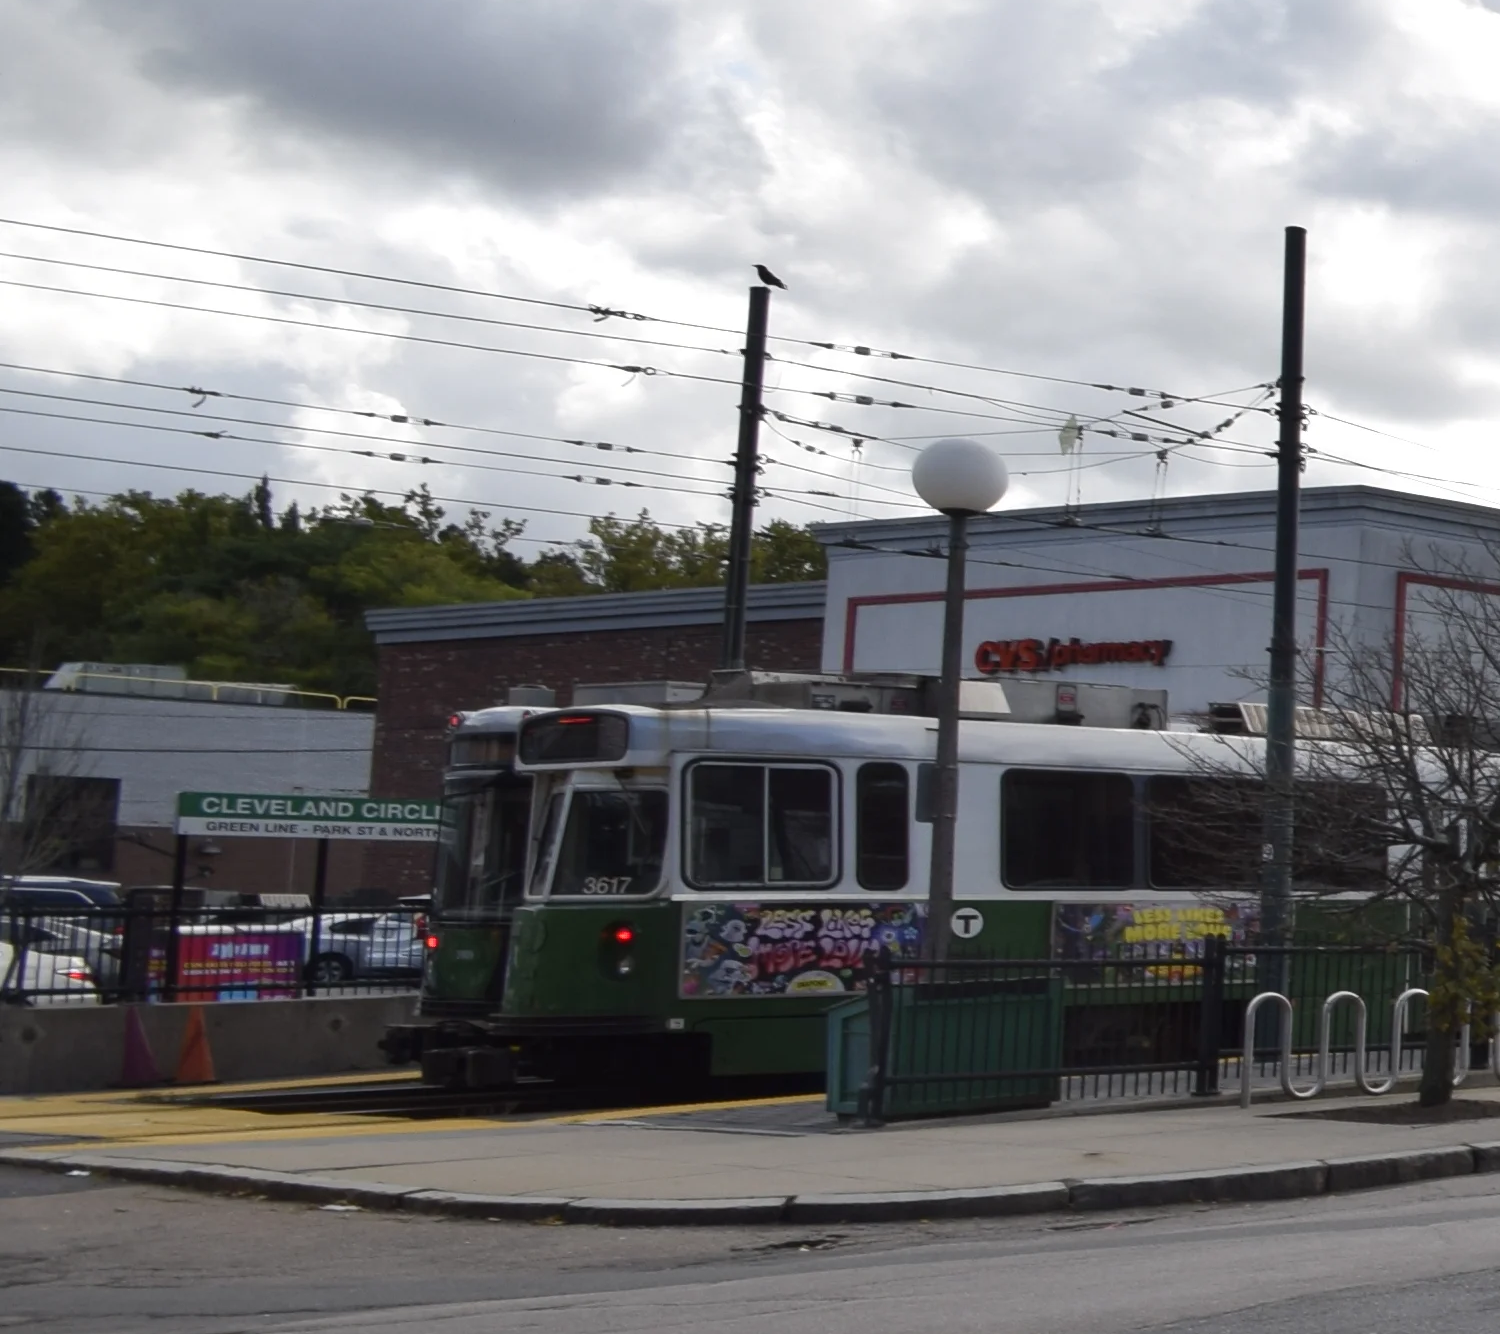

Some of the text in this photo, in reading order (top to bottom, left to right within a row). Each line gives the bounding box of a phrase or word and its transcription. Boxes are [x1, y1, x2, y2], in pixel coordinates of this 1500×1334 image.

[202, 797, 354, 818] CLEVELAND
[206, 821, 259, 833] GREEN
[264, 823, 299, 834] LINE
[312, 824, 351, 836] PARK
[357, 825, 376, 836] ST
[379, 827, 388, 837] &
[582, 876, 632, 895] 3617
[1125, 924, 1181, 943] MORE
